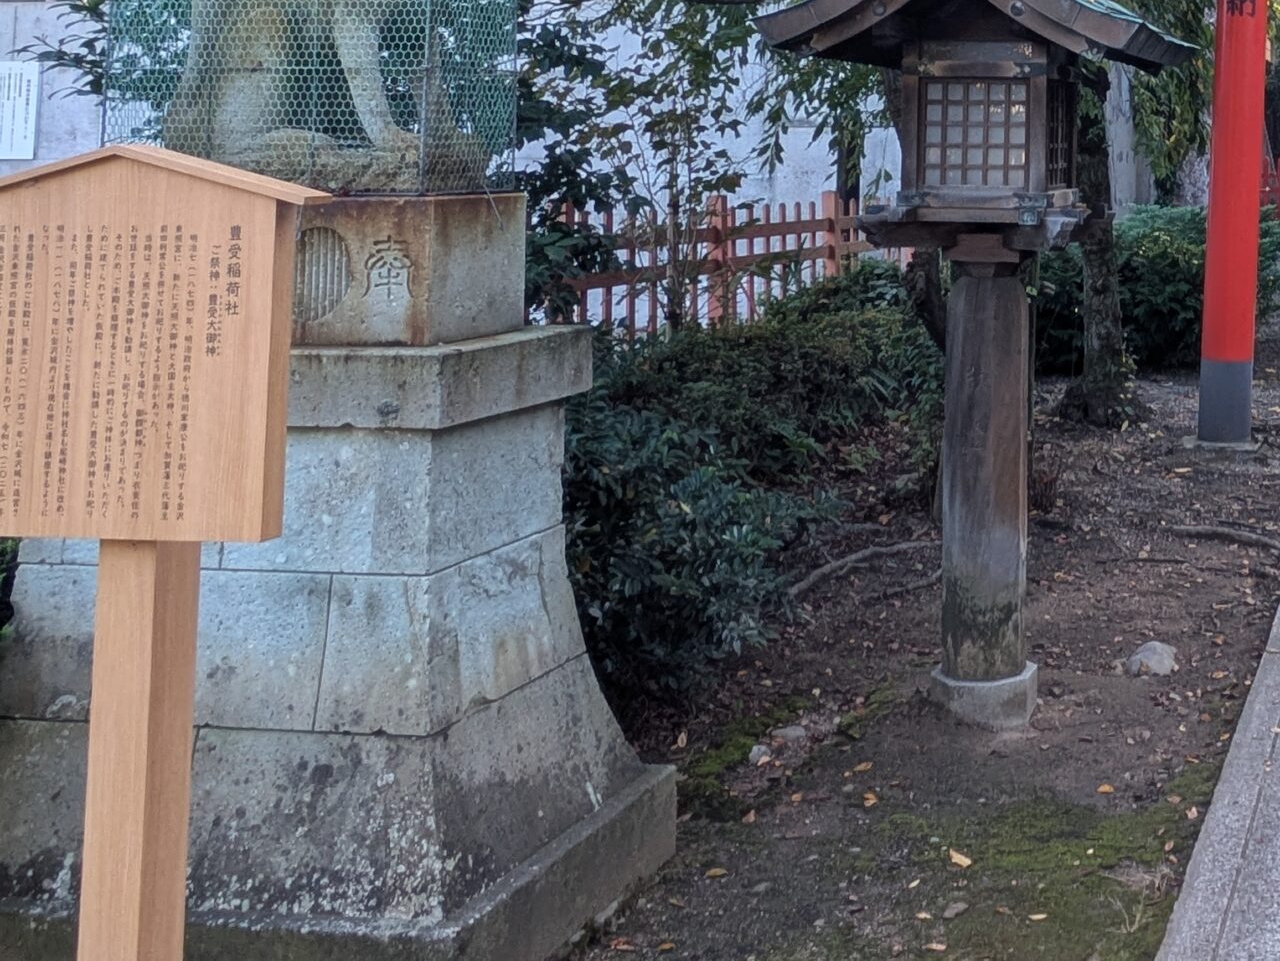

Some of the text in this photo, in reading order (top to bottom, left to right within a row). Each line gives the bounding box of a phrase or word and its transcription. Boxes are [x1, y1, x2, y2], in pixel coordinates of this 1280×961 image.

[224, 223, 243, 316] 豊受稲荷社
